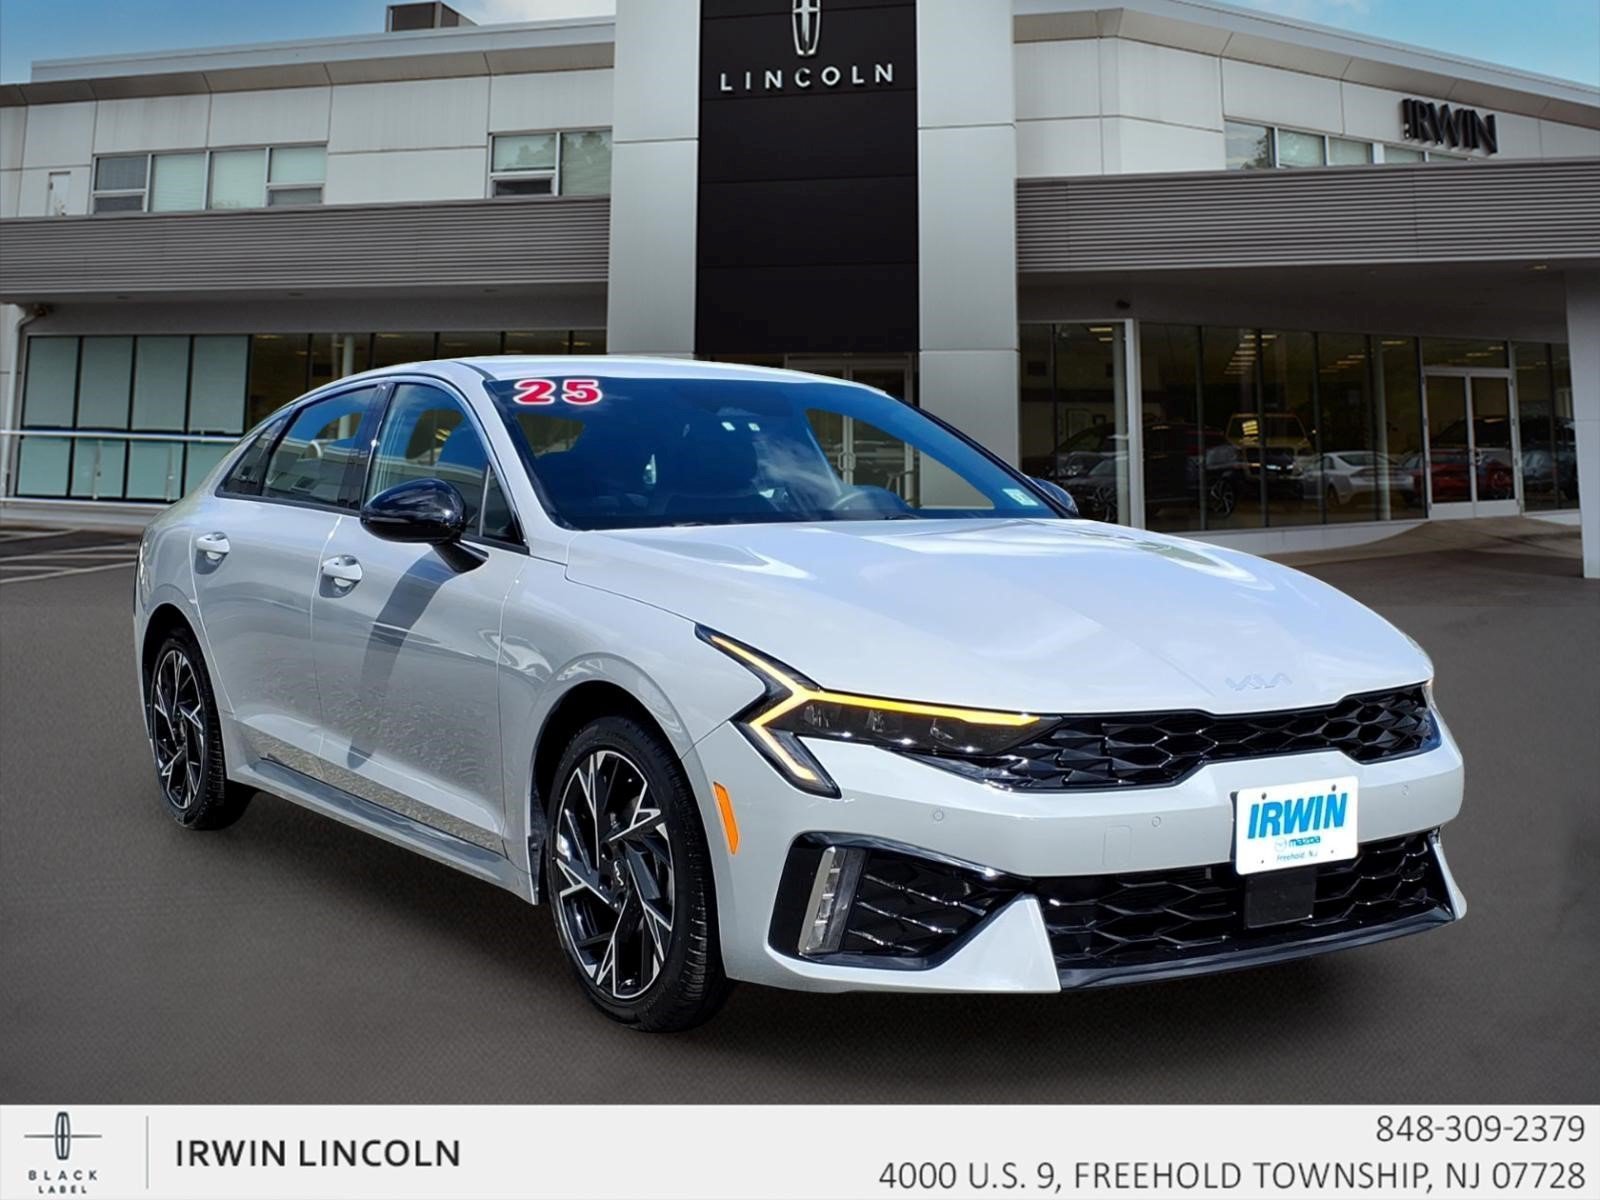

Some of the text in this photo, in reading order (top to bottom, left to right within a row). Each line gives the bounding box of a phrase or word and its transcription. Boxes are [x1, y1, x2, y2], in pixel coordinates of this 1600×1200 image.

[719, 63, 893, 91] LINCOLN
[1400, 98, 1498, 153] IRWIN
[513, 379, 603, 405] 25
[1248, 792, 1348, 839] IRWIN
